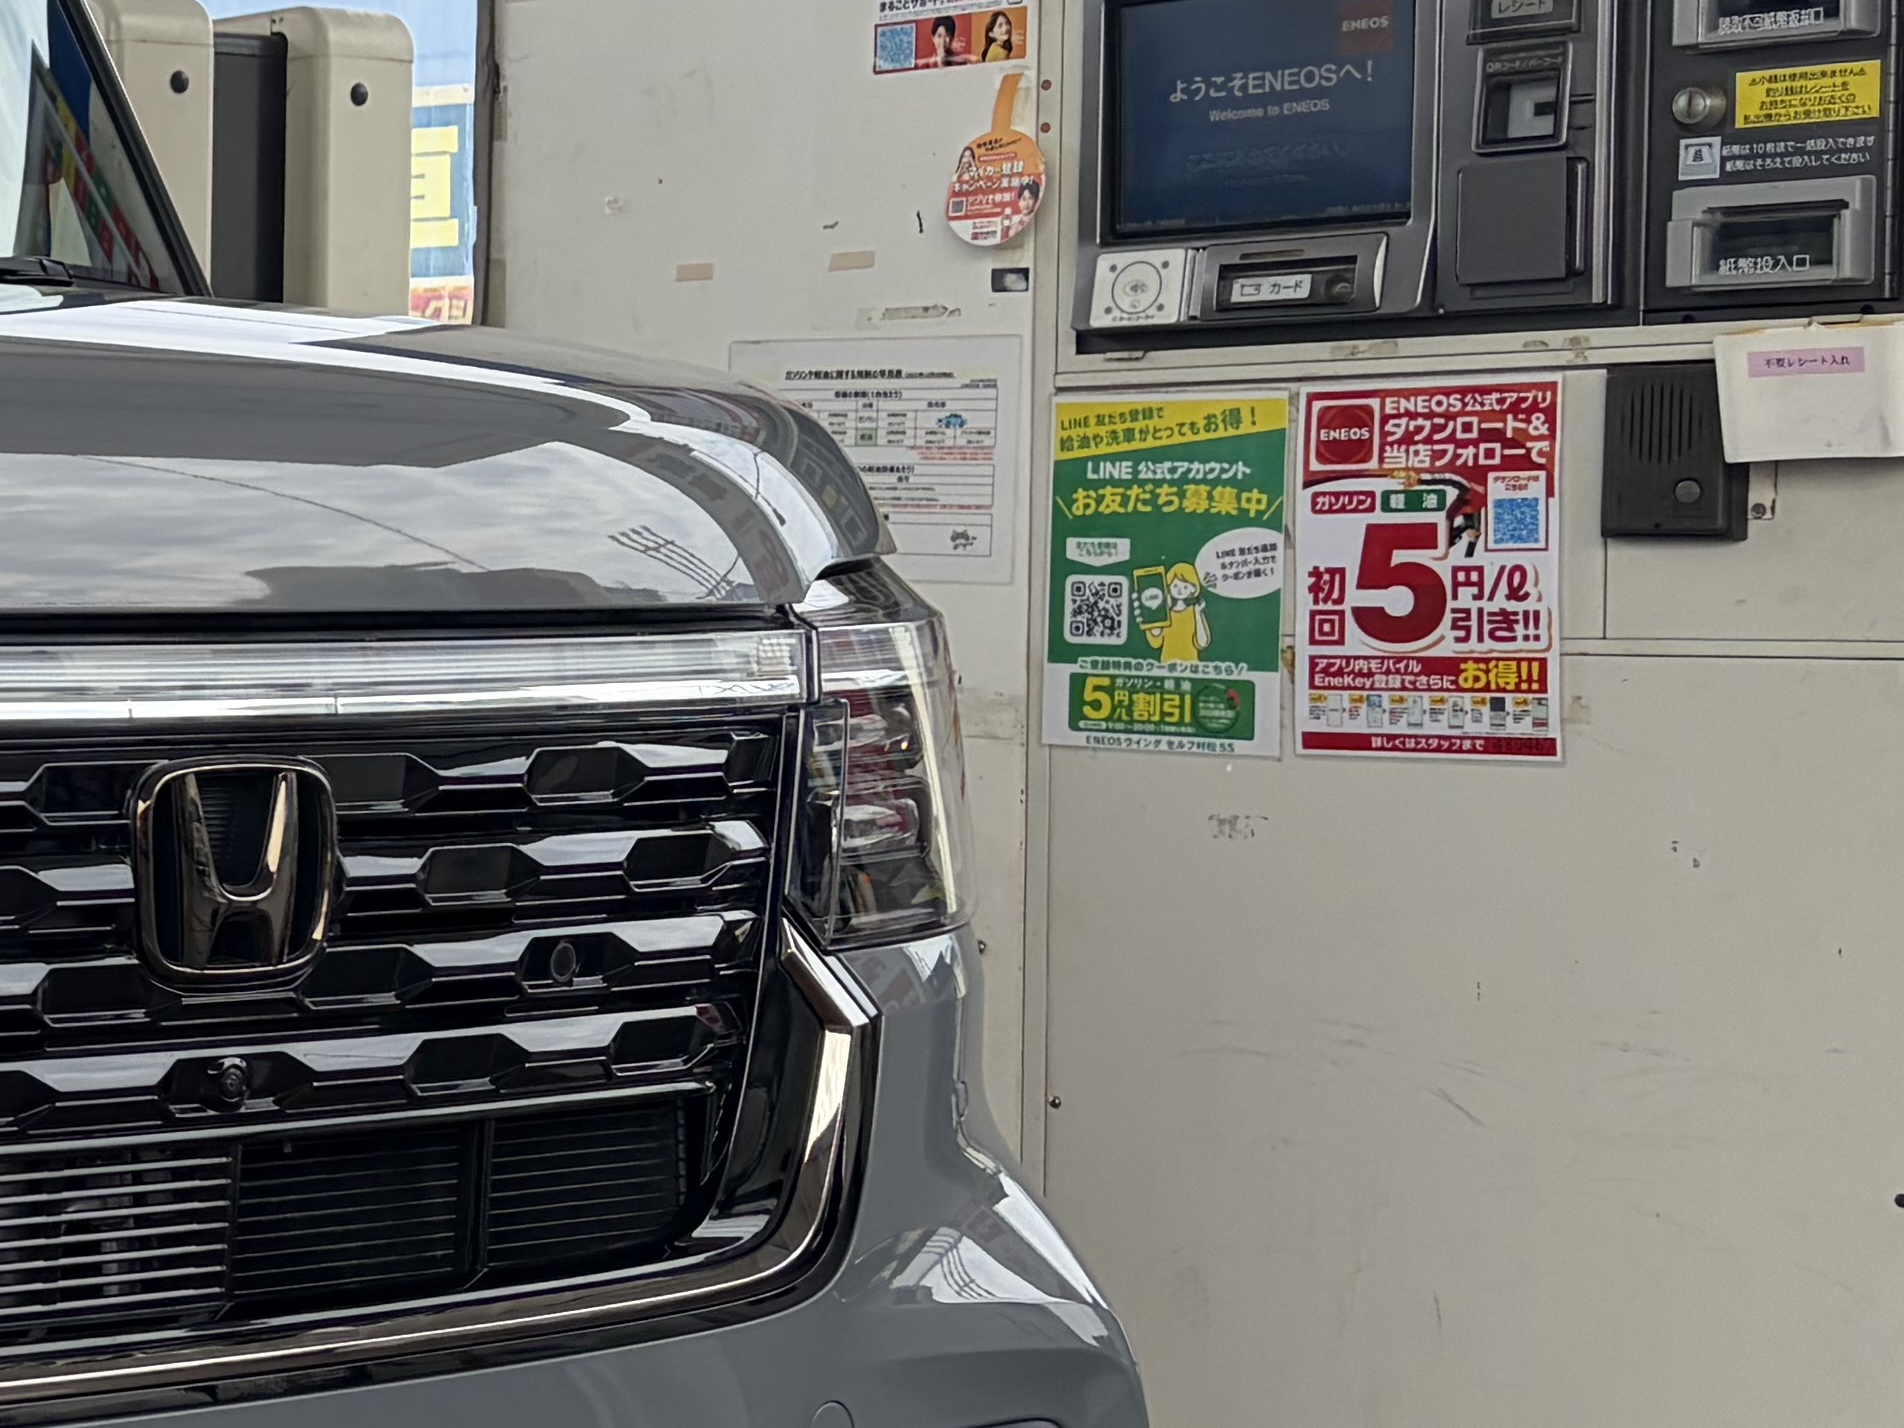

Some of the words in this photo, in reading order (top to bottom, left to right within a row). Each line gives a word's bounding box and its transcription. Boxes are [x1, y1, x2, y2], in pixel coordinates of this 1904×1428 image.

[1342, 15, 1390, 32] ENEOS
[1209, 104, 1265, 122] Welcome
[1267, 104, 1281, 116] to
[1283, 98, 1331, 115] ENEOS
[1718, 254, 1810, 275] 紙幣投入口
[1269, 279, 1304, 295] カード
[1060, 415, 1091, 431] LINE
[1384, 413, 1550, 442] ダウンロード&
[1319, 427, 1371, 442] ENEOS
[1382, 440, 1551, 469] 当店フォローで
[1086, 461, 1133, 480] LINE
[1137, 460, 1252, 481] 公式アカウント
[1071, 482, 1269, 518] お友だち募集中
[1314, 493, 1373, 511] ガソリン
[1350, 522, 1448, 645] 5
[1449, 606, 1542, 645] 引き!!
[1314, 657, 1423, 674] アプリ内モバイル
[1457, 658, 1540, 692] お得!!
[1082, 676, 1113, 721] 5
[1131, 691, 1192, 724] 割引
